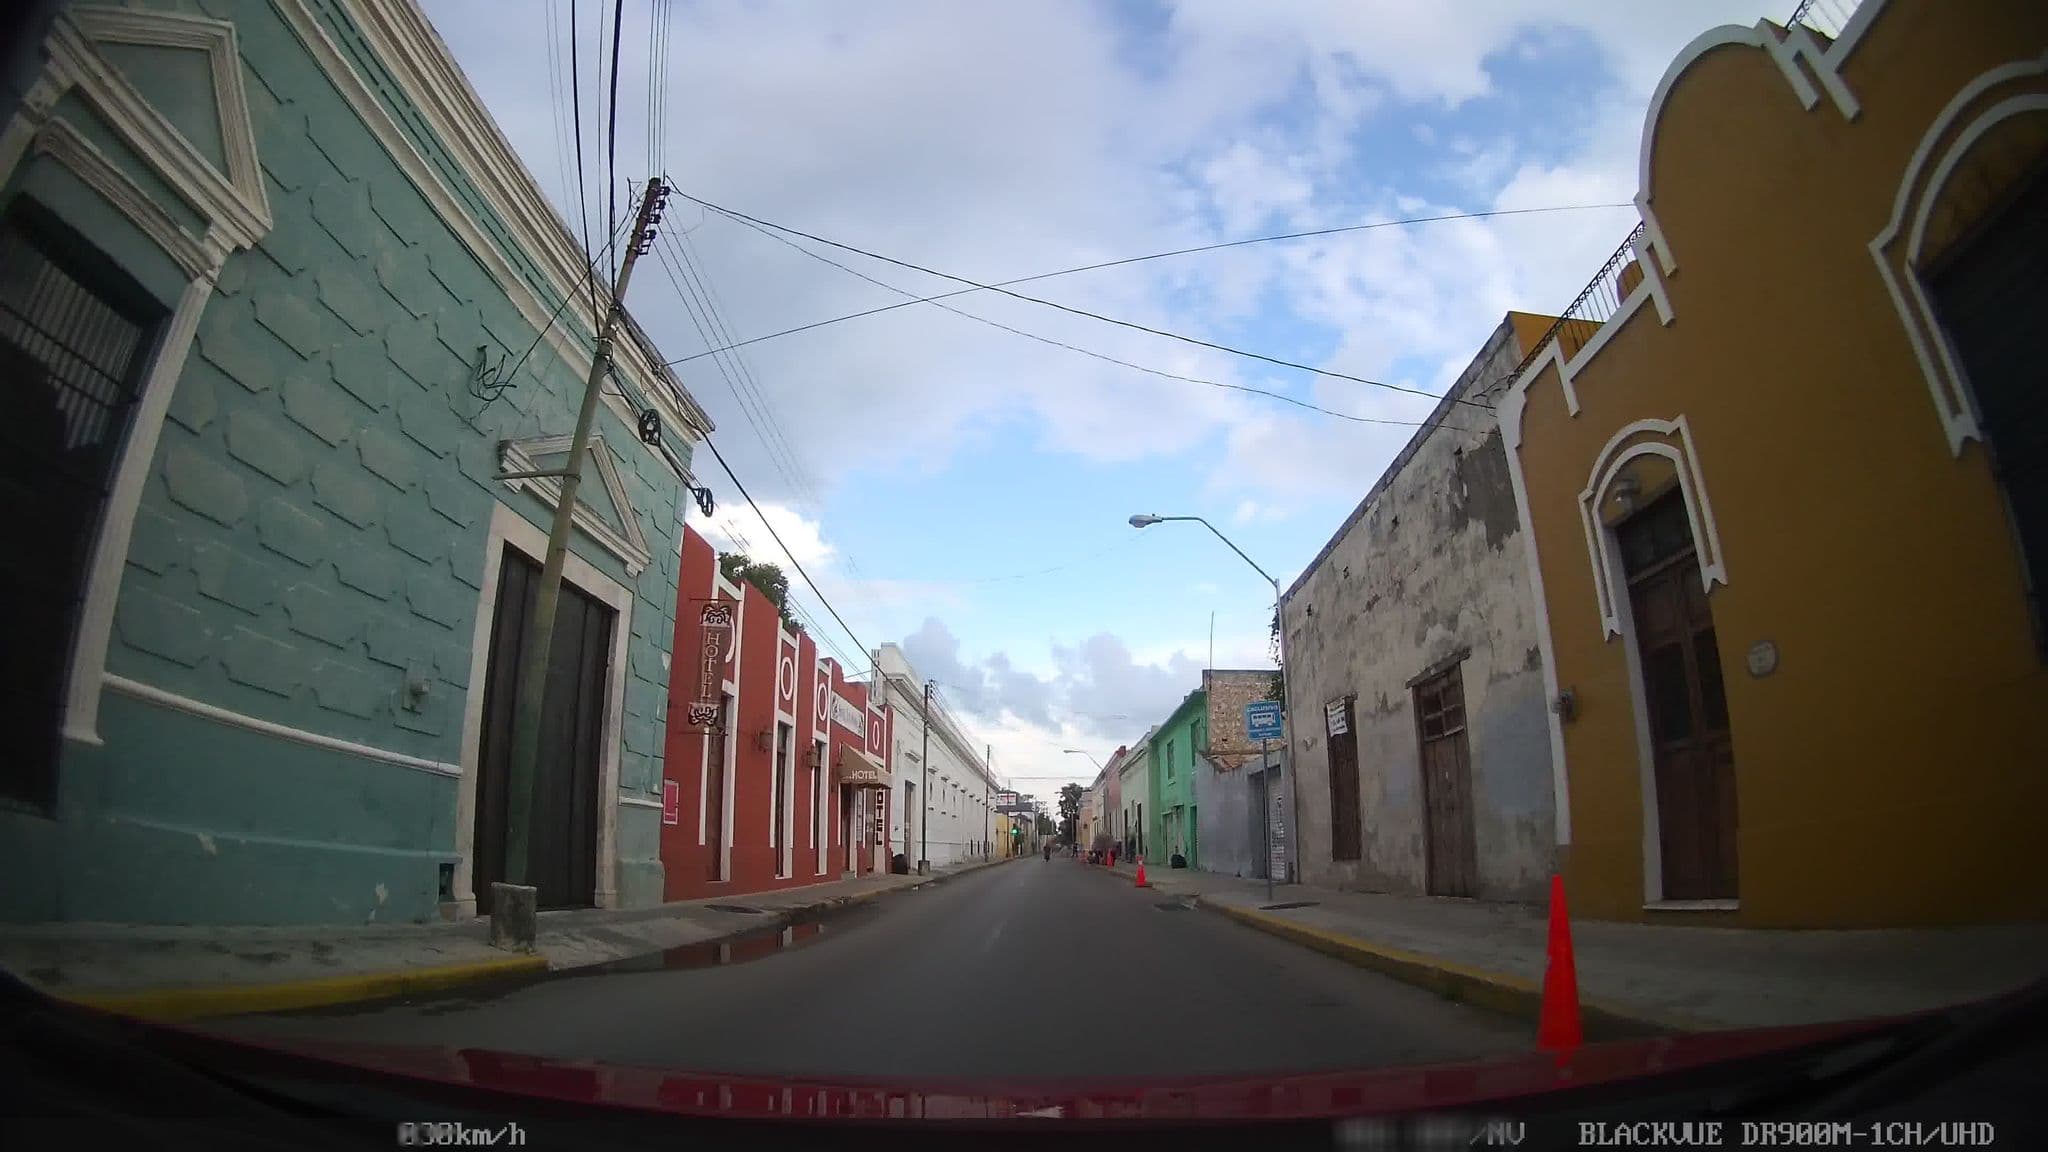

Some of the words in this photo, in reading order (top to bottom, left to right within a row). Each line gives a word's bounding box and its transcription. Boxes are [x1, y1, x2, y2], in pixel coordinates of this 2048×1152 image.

[702, 632, 720, 698] HOTEL
[851, 770, 877, 780] HOTEL
[876, 789, 884, 846] OTEL
